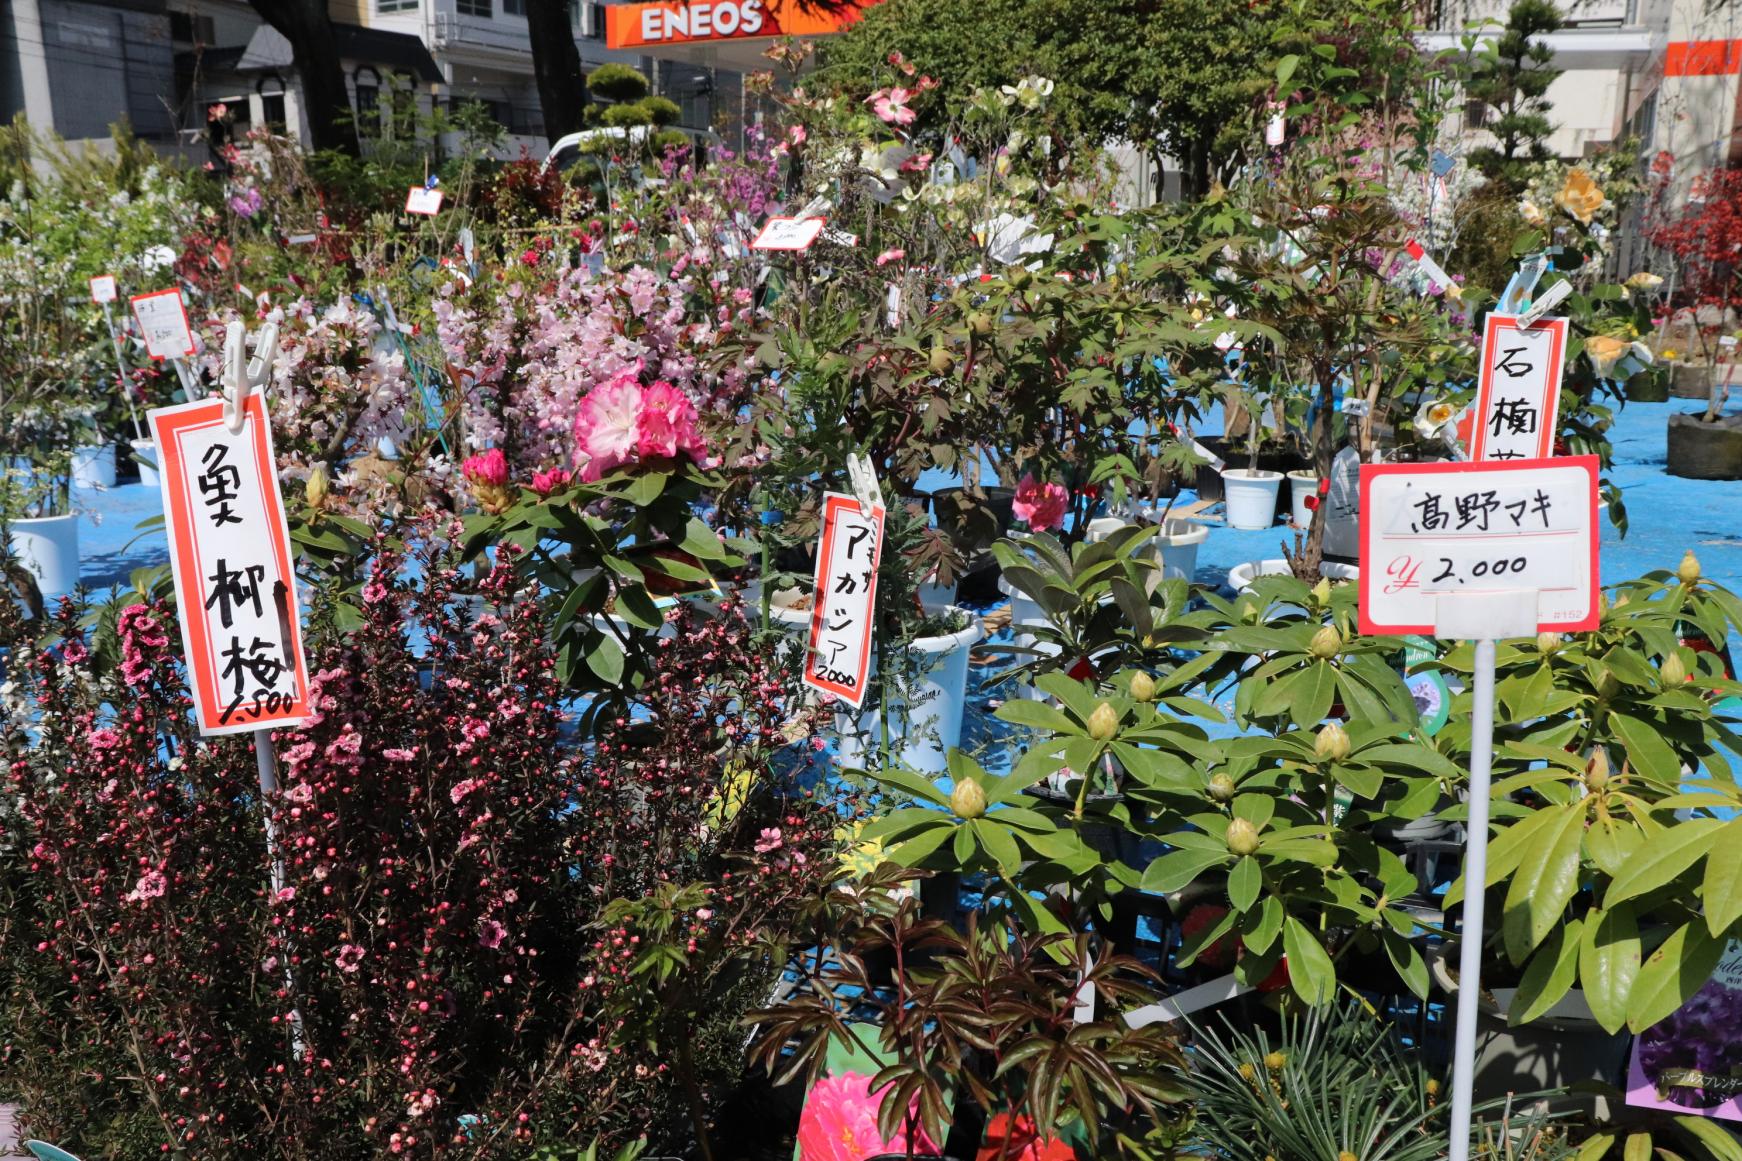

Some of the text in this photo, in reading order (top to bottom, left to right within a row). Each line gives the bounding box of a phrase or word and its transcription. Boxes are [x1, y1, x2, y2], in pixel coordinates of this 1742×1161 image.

[641, 0, 763, 41] ENEOS
[1488, 346, 1537, 459] 石楠
[815, 664, 856, 688] 2000
